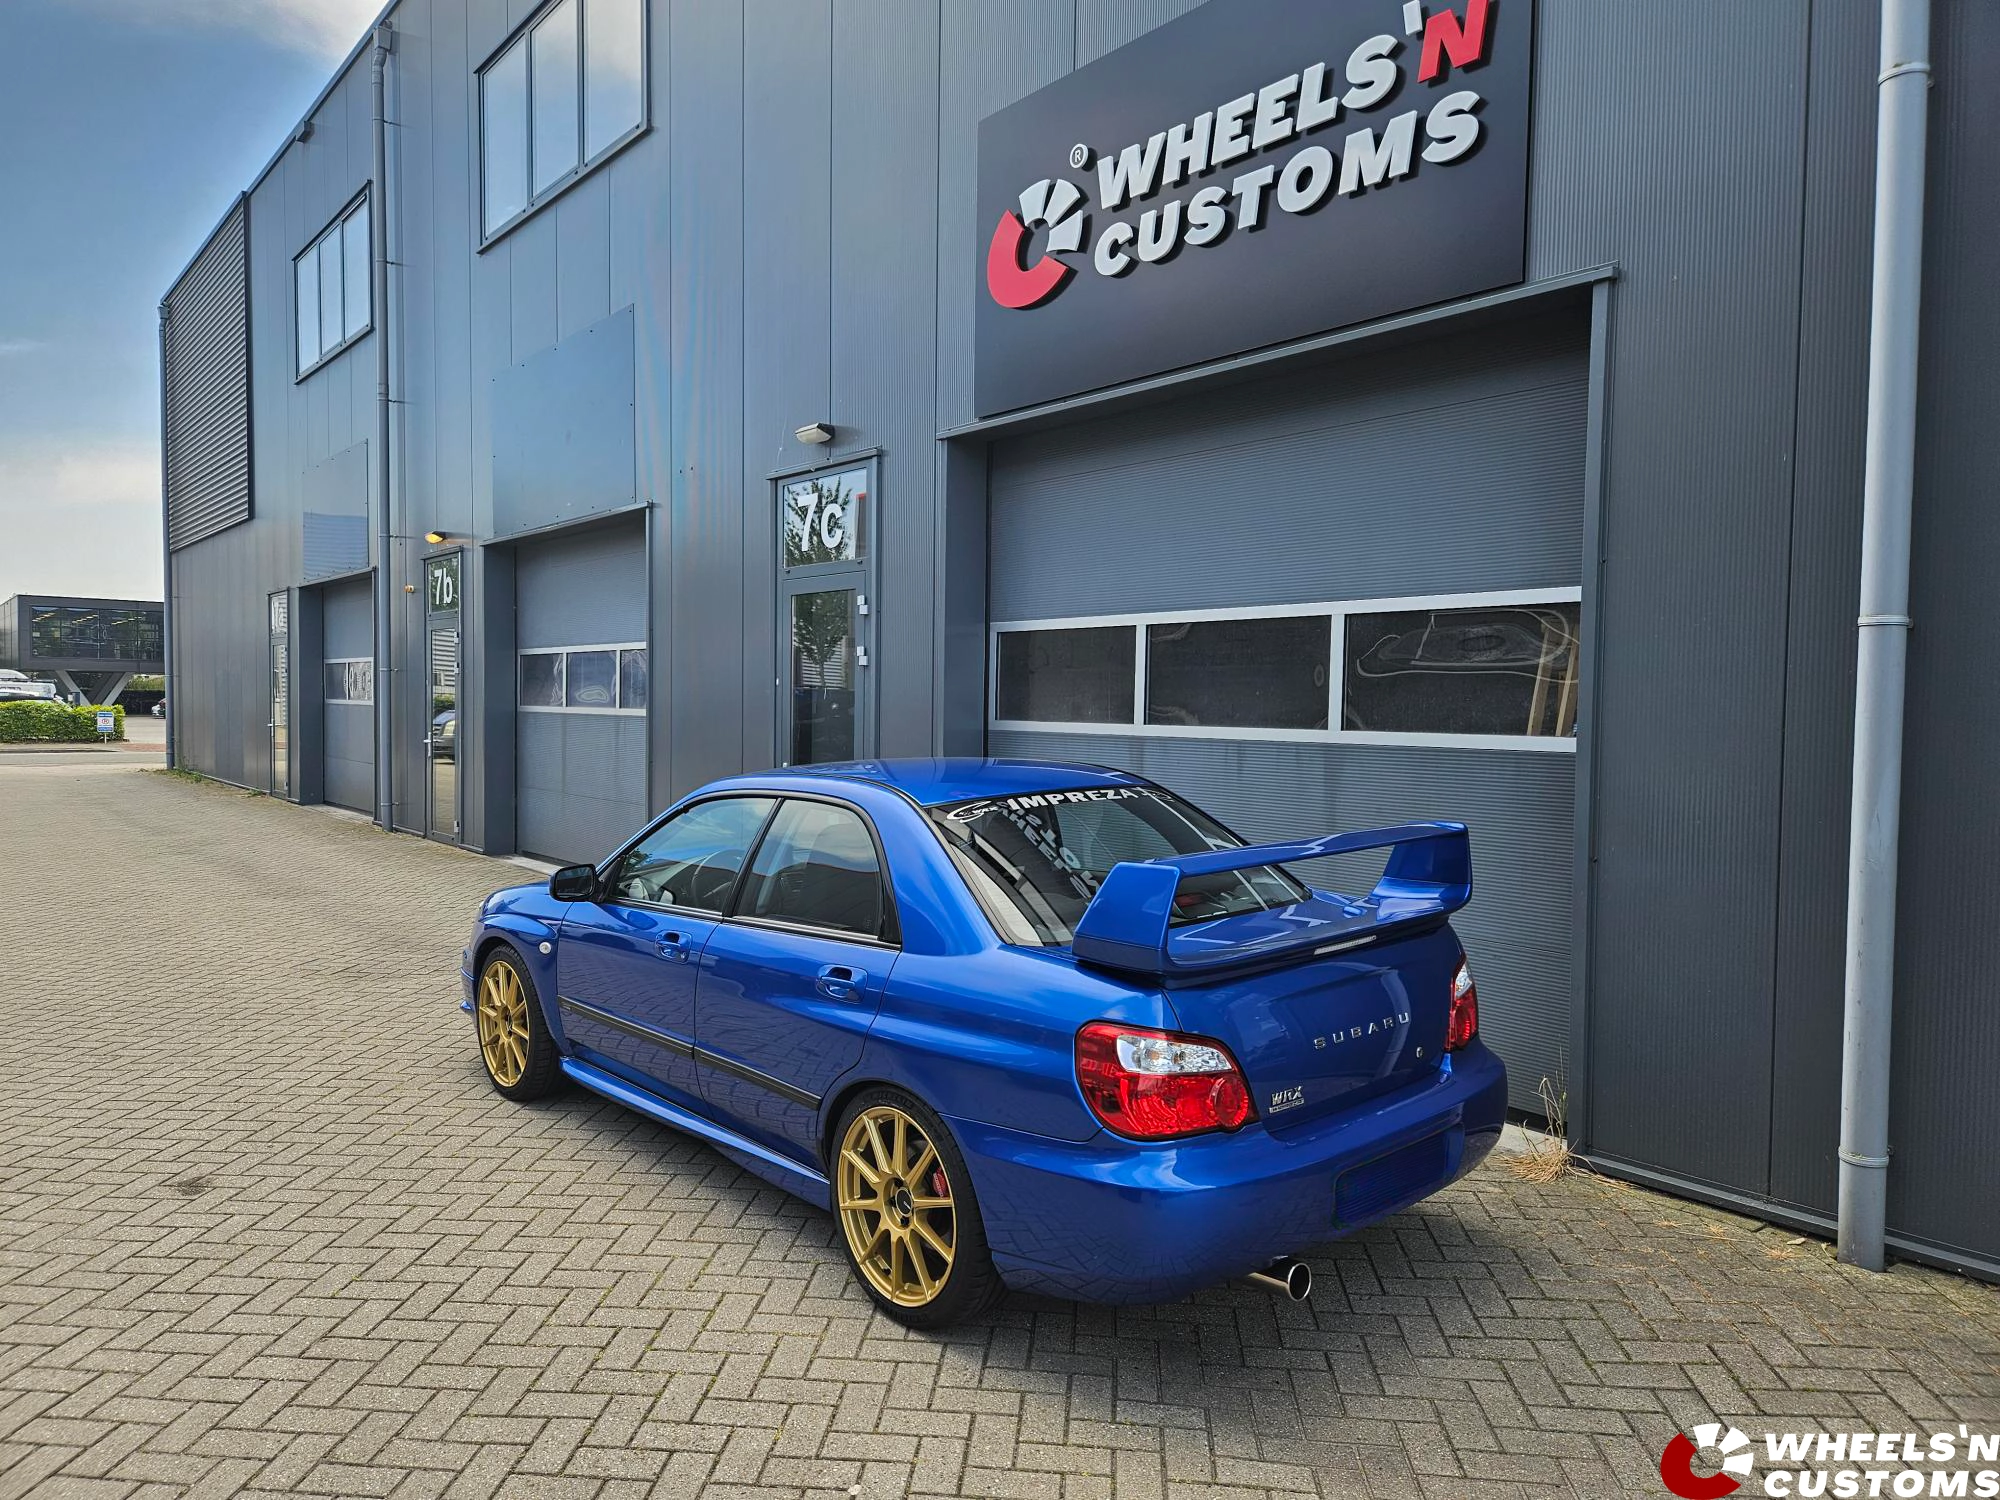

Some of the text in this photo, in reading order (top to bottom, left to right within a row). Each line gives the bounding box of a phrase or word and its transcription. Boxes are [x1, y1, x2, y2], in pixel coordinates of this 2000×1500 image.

[1094, 90, 1481, 276] CUSTOMS
[434, 568, 453, 604] 7b
[1006, 788, 1139, 811] IMPREZA
[1314, 1012, 1410, 1050] SUBARU
[1271, 1086, 1303, 1106] WRX
